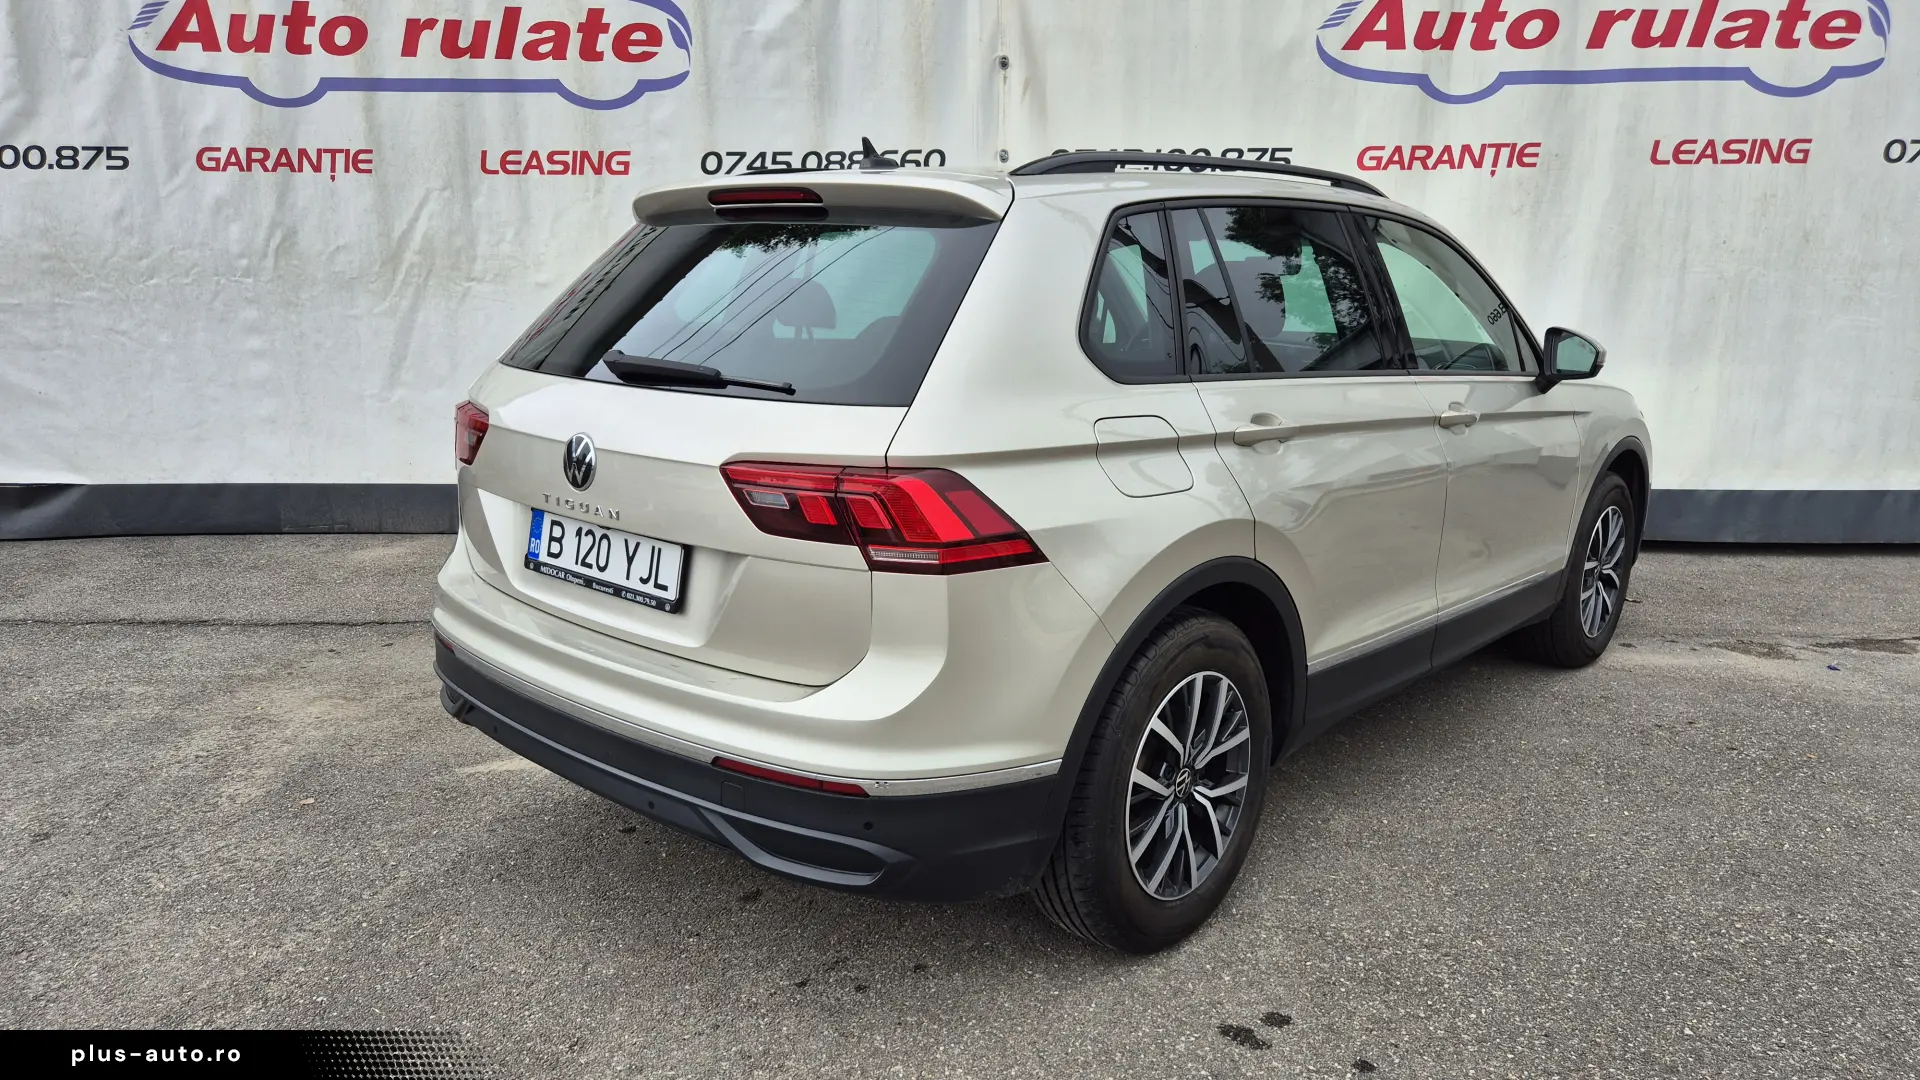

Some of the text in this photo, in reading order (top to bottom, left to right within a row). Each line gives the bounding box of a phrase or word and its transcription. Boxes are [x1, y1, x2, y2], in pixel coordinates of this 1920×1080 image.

[157, 0, 664, 63] Auto rulate
[1341, 0, 1862, 52] Auto rulate
[480, 149, 631, 176] LEASING
[1650, 138, 1813, 165] LEASING
[542, 492, 620, 521] TIGUAN
[529, 537, 541, 555] RO
[546, 519, 669, 593] B 120 YJL
